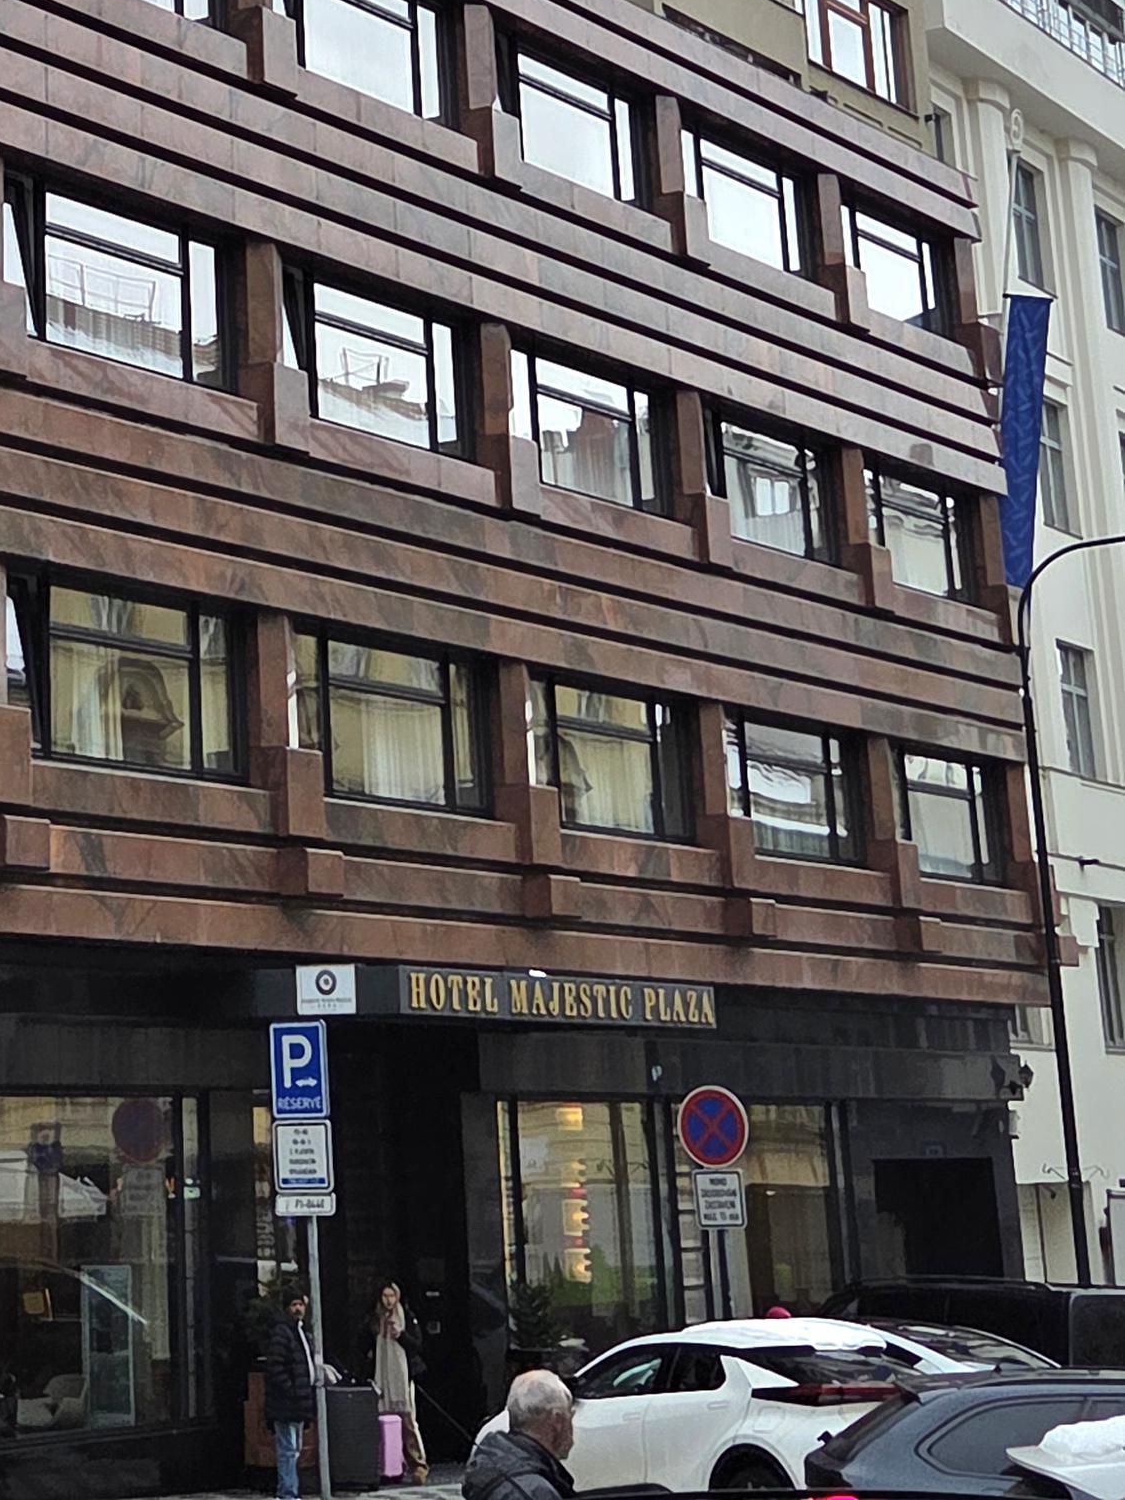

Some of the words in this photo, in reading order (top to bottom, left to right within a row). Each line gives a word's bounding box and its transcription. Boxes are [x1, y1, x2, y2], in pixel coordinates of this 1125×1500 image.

[409, 971, 499, 1013] HOTEL
[509, 978, 633, 1020] MAJESTIC
[643, 987, 715, 1024] PLAZA
[281, 1033, 313, 1089] P
